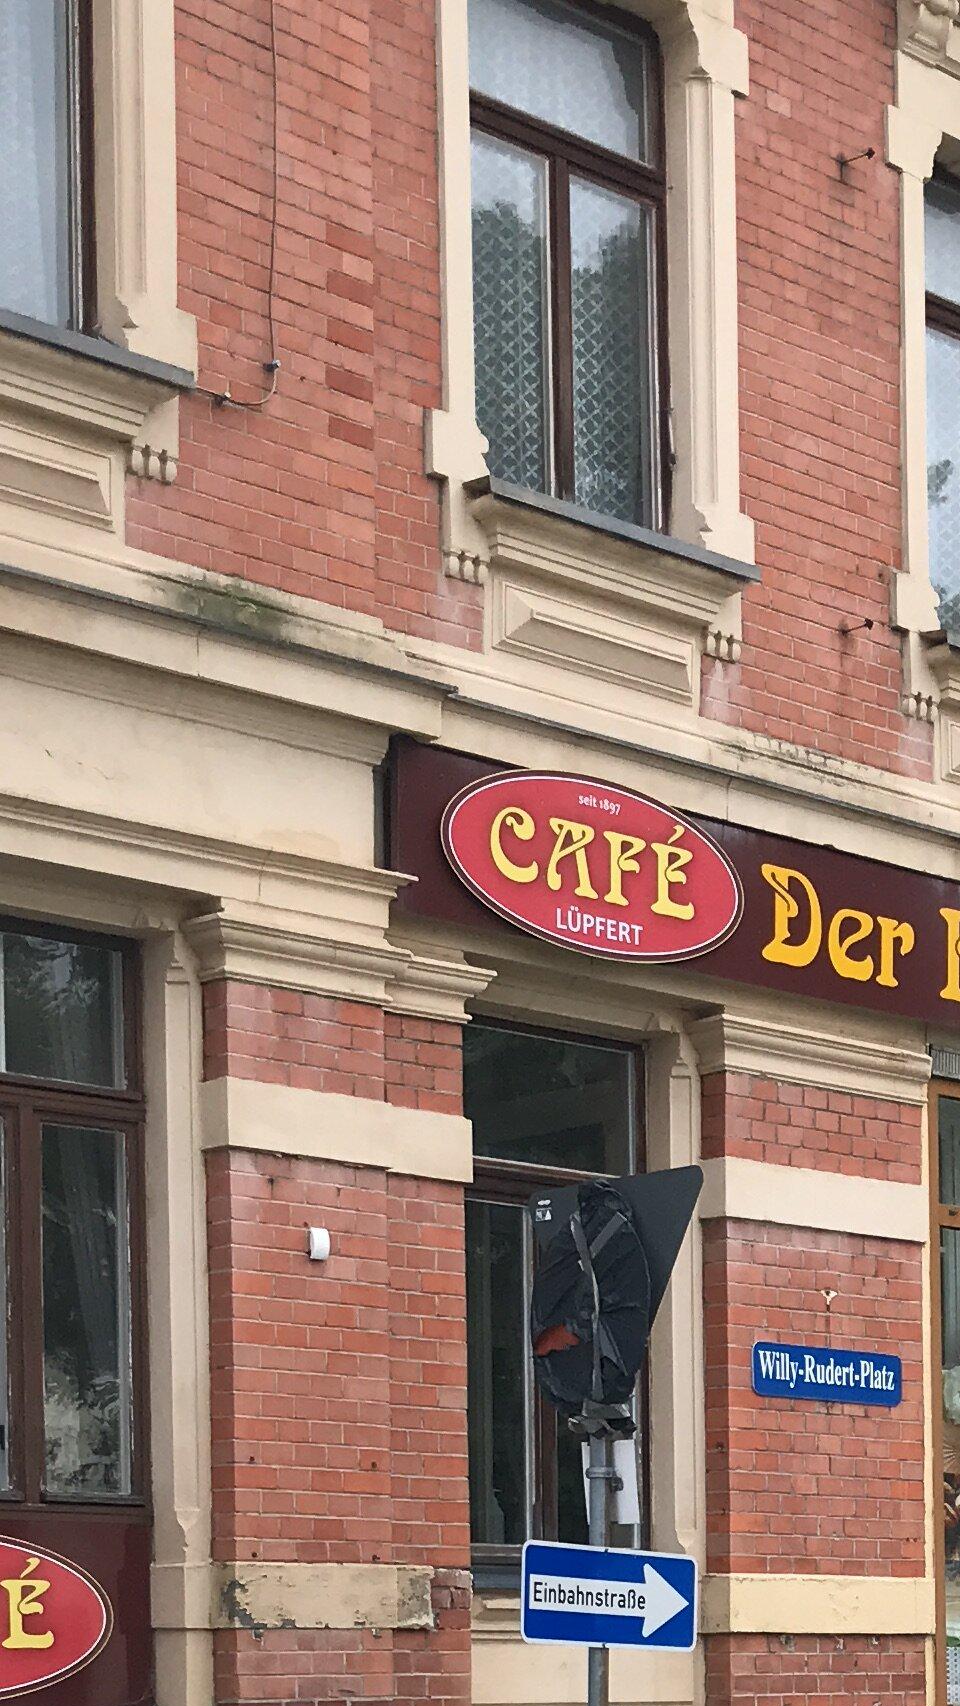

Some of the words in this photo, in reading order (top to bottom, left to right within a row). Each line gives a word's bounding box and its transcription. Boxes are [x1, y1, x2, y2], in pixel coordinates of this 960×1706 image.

[578, 794, 598, 808] seit
[599, 798, 621, 816] 1897
[490, 807, 695, 921] CAFÉ
[555, 905, 644, 946] LÜPFERT
[760, 863, 916, 988] Der
[757, 1349, 896, 1391] Willy-Rudert-Platz
[533, 1581, 646, 1610] Einbahnstraße
